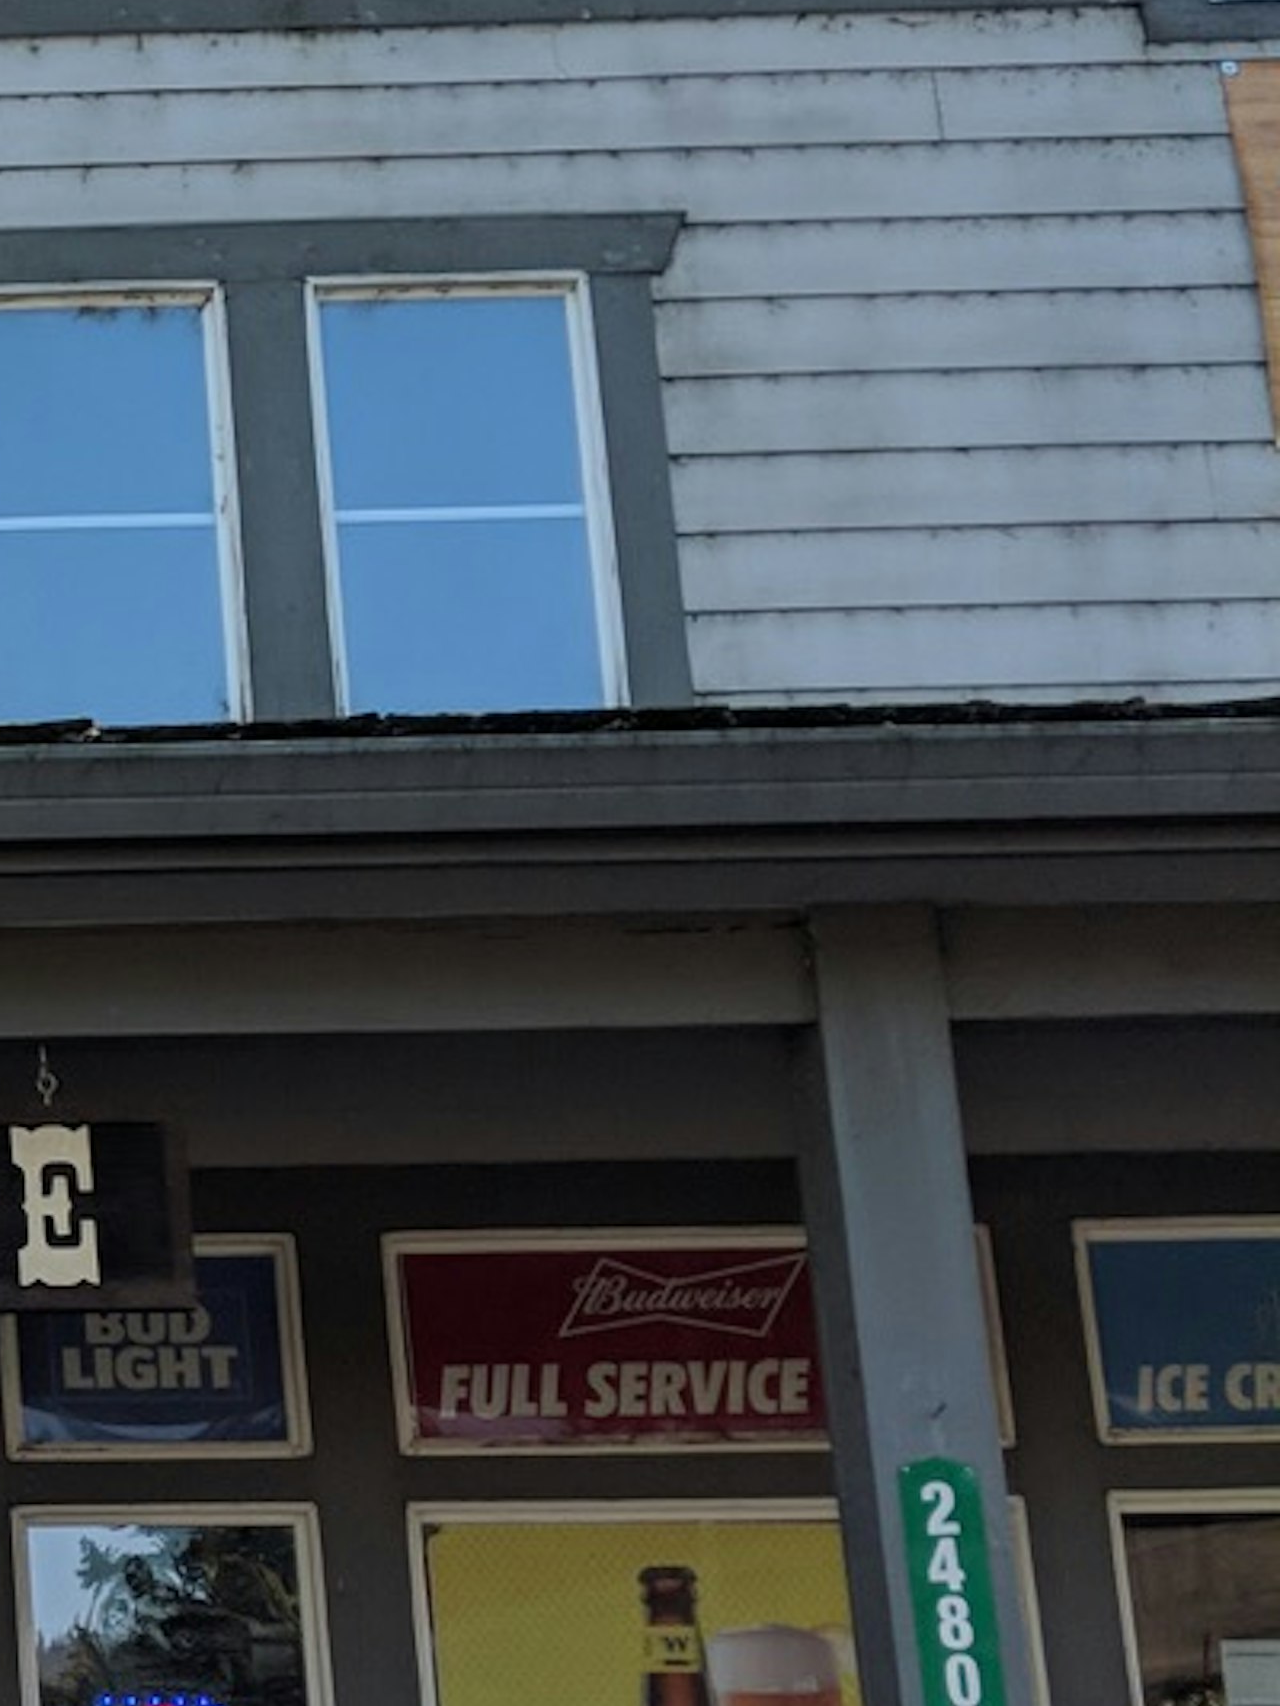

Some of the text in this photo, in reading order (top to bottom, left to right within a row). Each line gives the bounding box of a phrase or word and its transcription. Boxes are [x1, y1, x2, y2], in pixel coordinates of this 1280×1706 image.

[572, 1272, 785, 1316] Budweiser
[85, 1305, 212, 1344] BUD
[61, 1346, 239, 1390] LIGHT
[439, 1356, 811, 1420] FULL SERVICE
[1138, 1362, 1210, 1413] ICE
